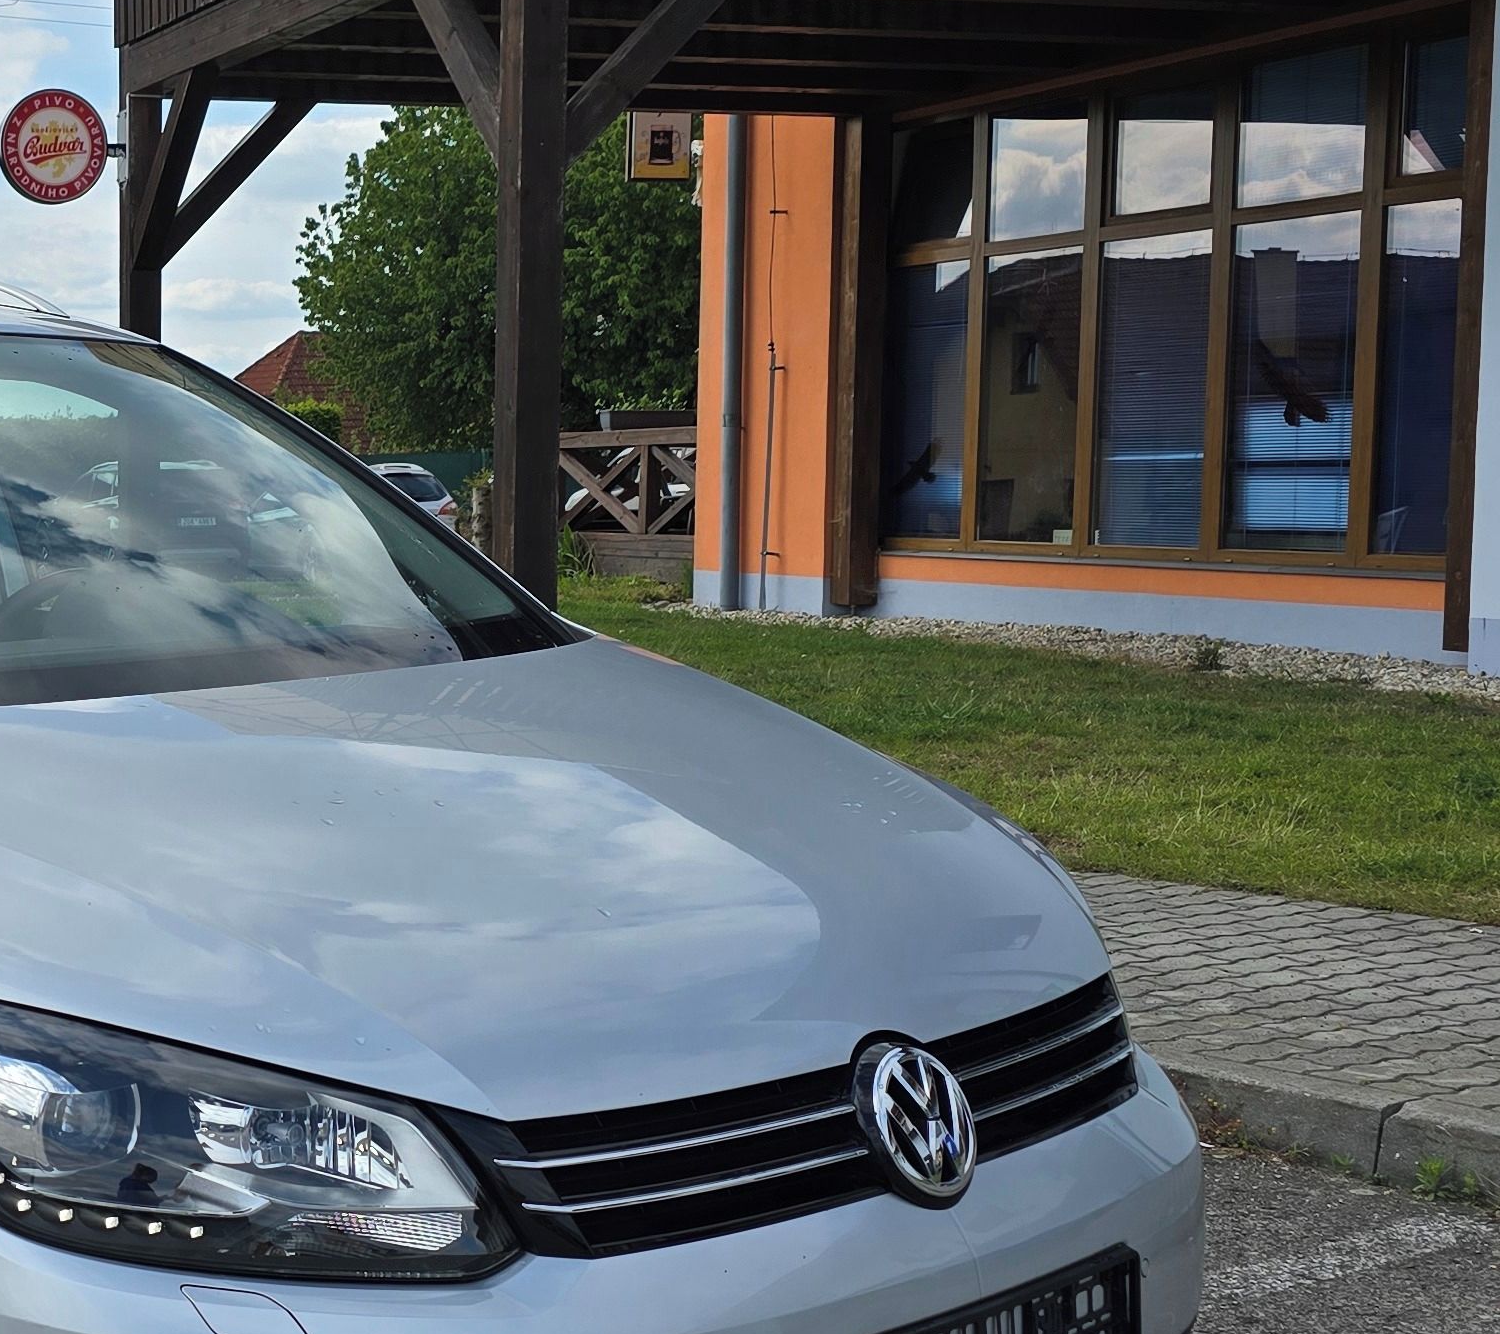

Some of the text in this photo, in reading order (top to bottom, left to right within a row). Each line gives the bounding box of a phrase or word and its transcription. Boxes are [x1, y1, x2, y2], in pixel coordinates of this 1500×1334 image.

[33, 96, 75, 109] PIVO
[11, 116, 22, 127] Z
[74, 116, 103, 191] PIVOVARU
[23, 135, 87, 159] Budvar
